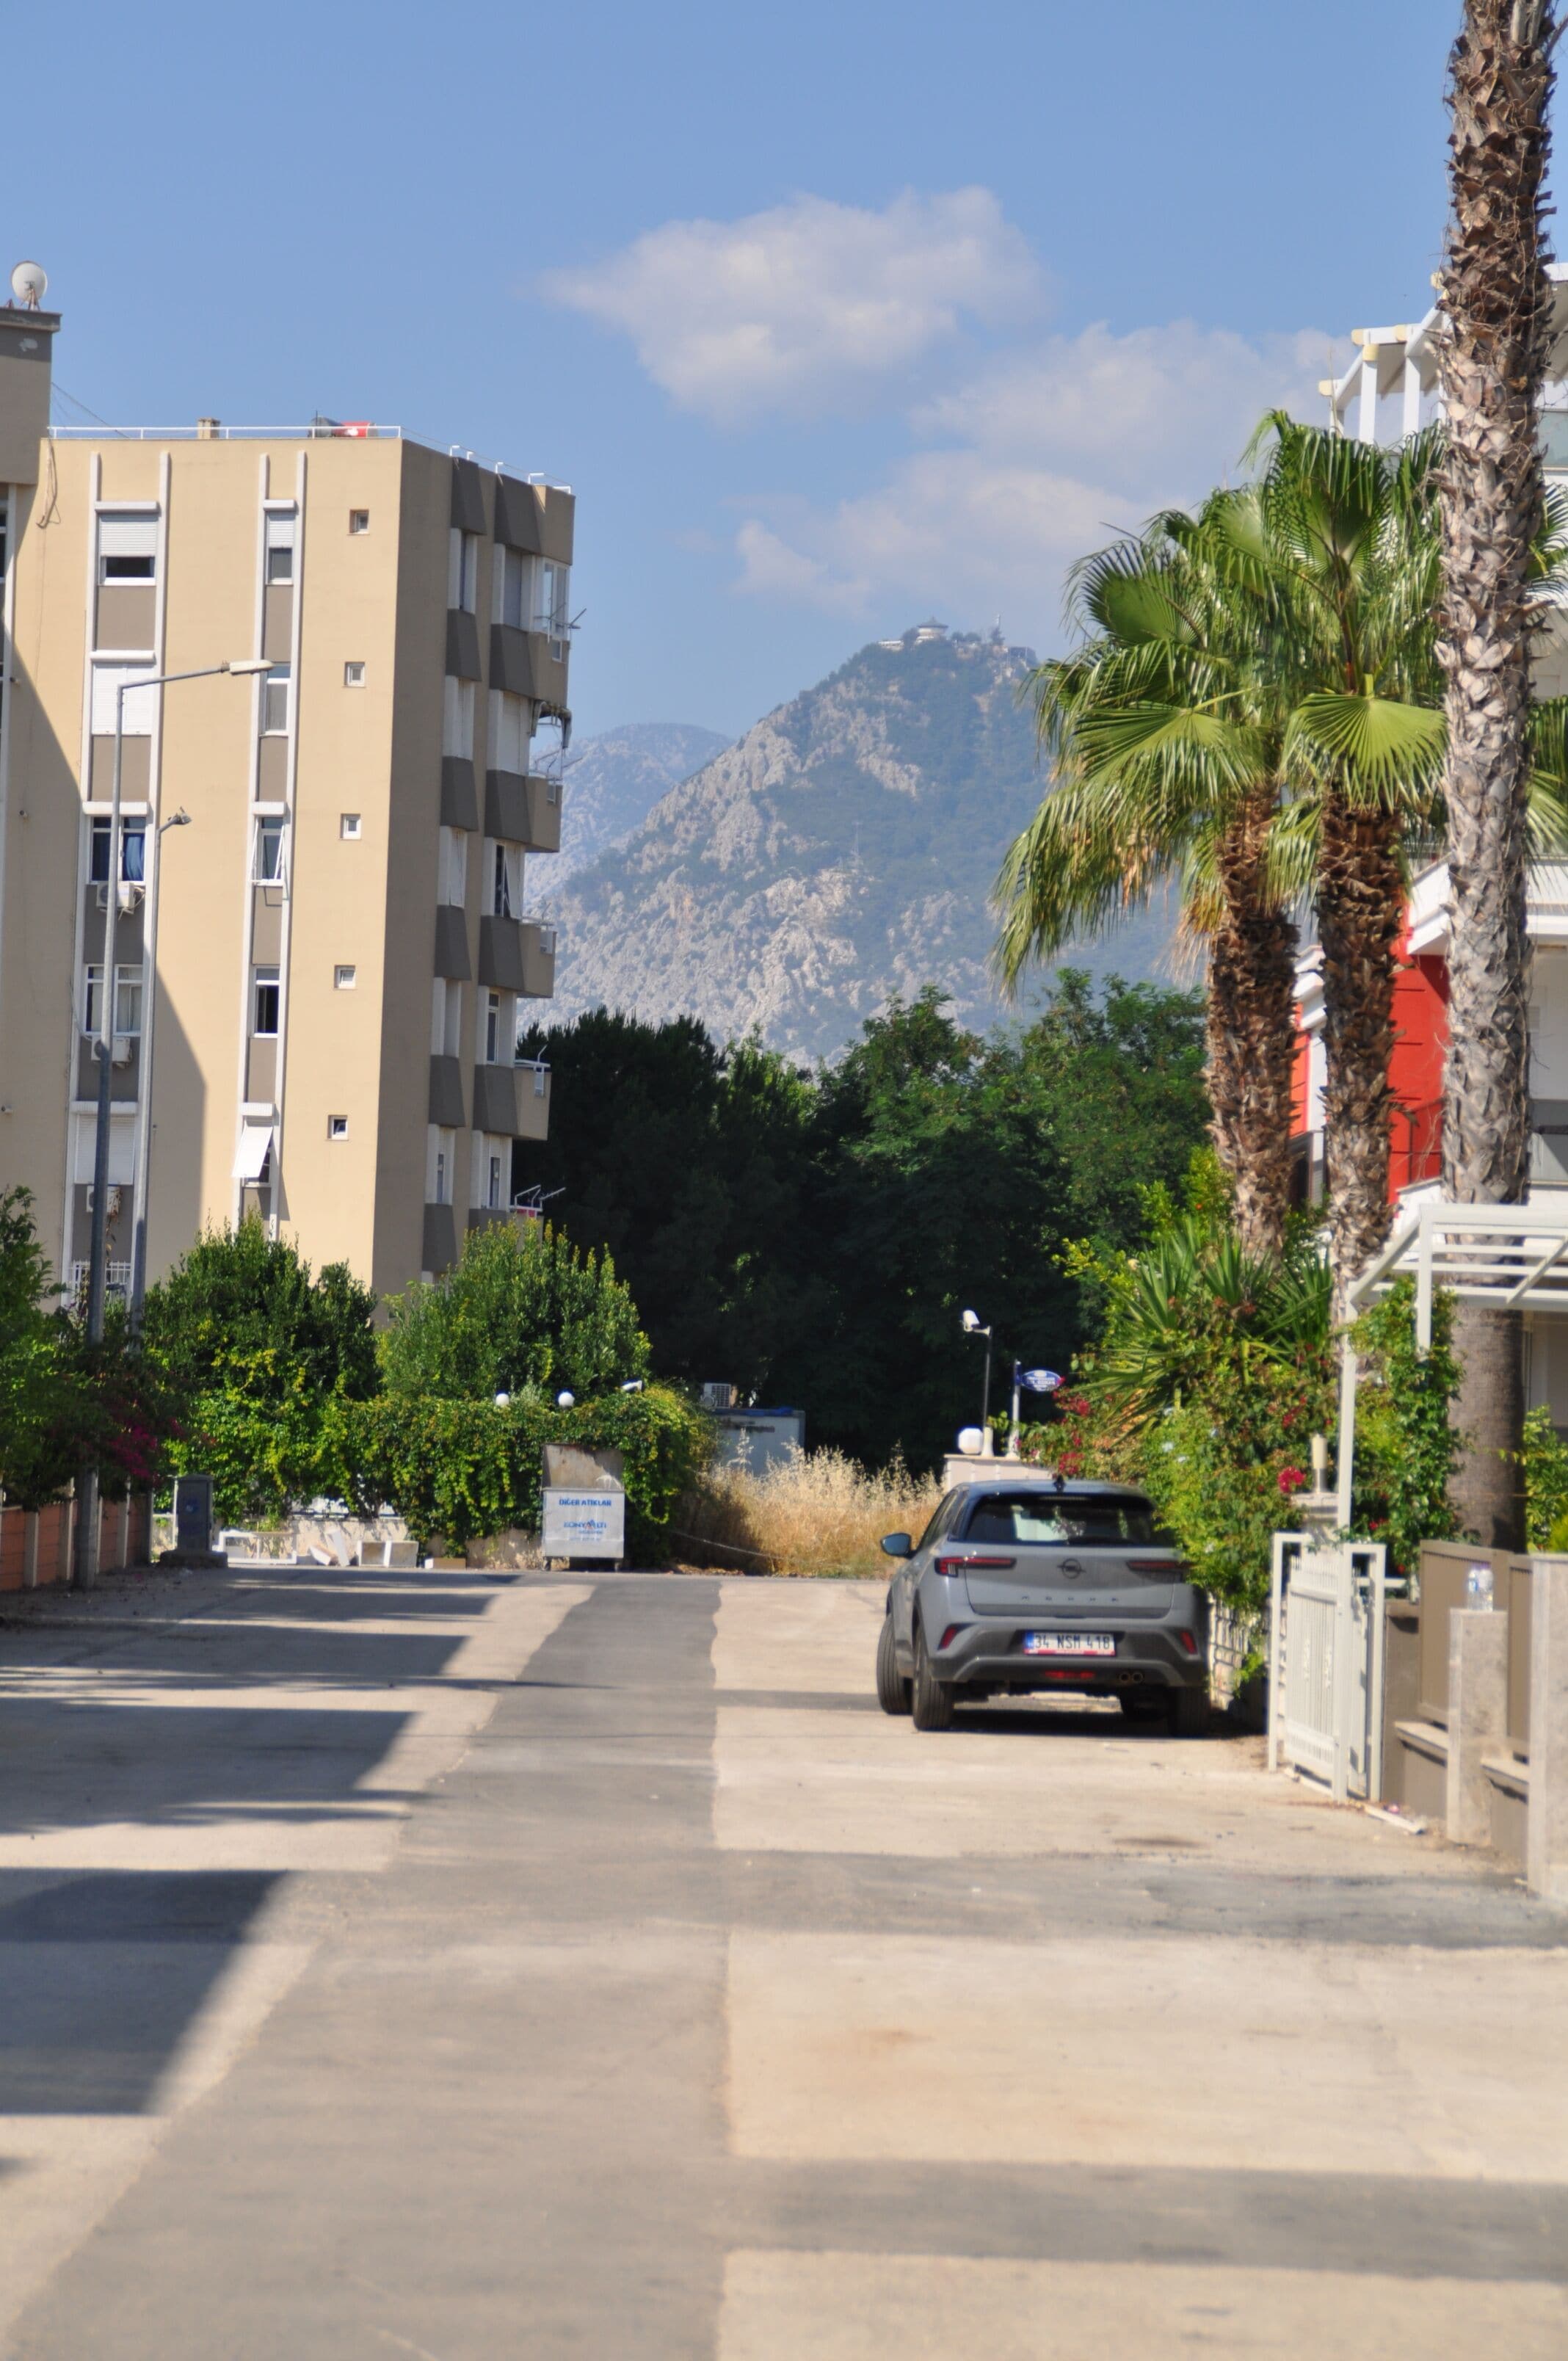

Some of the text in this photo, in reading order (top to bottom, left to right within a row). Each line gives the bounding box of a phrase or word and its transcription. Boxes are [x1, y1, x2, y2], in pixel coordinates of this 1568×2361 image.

[1035, 1635, 1110, 1650] 34 NSM 418
